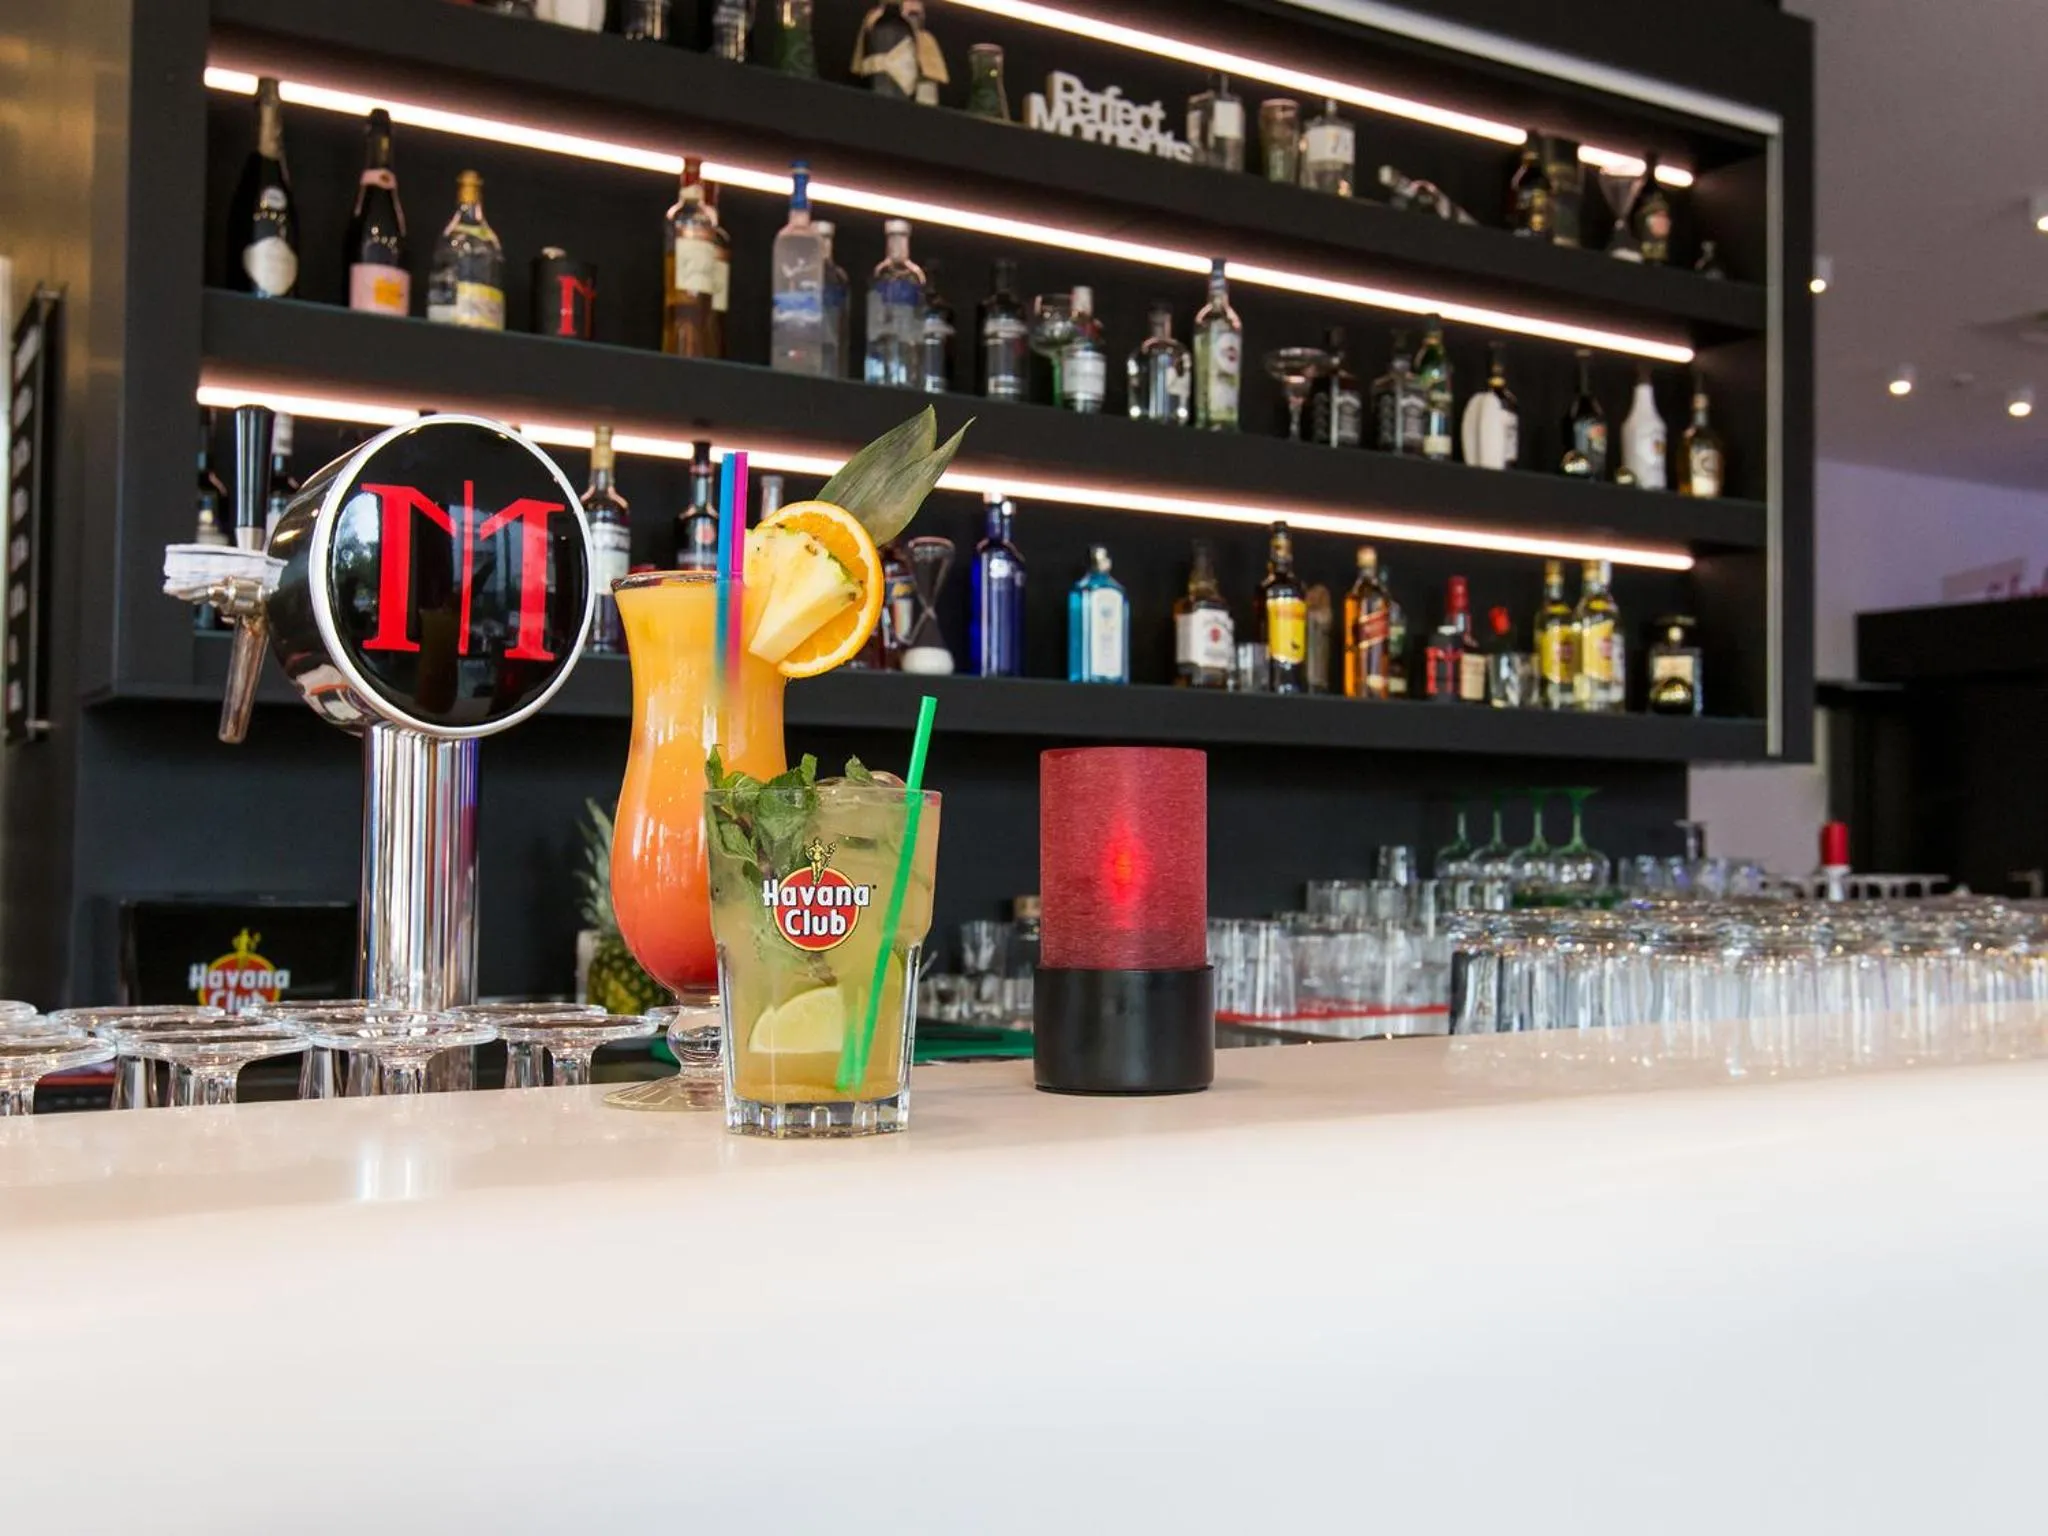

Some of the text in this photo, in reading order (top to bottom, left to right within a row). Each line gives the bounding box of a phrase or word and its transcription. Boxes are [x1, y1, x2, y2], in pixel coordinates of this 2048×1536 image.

[1047, 70, 1166, 132] Perfect
[763, 879, 869, 907] Havana
[784, 909, 846, 936] Club
[189, 963, 291, 990] Havana
